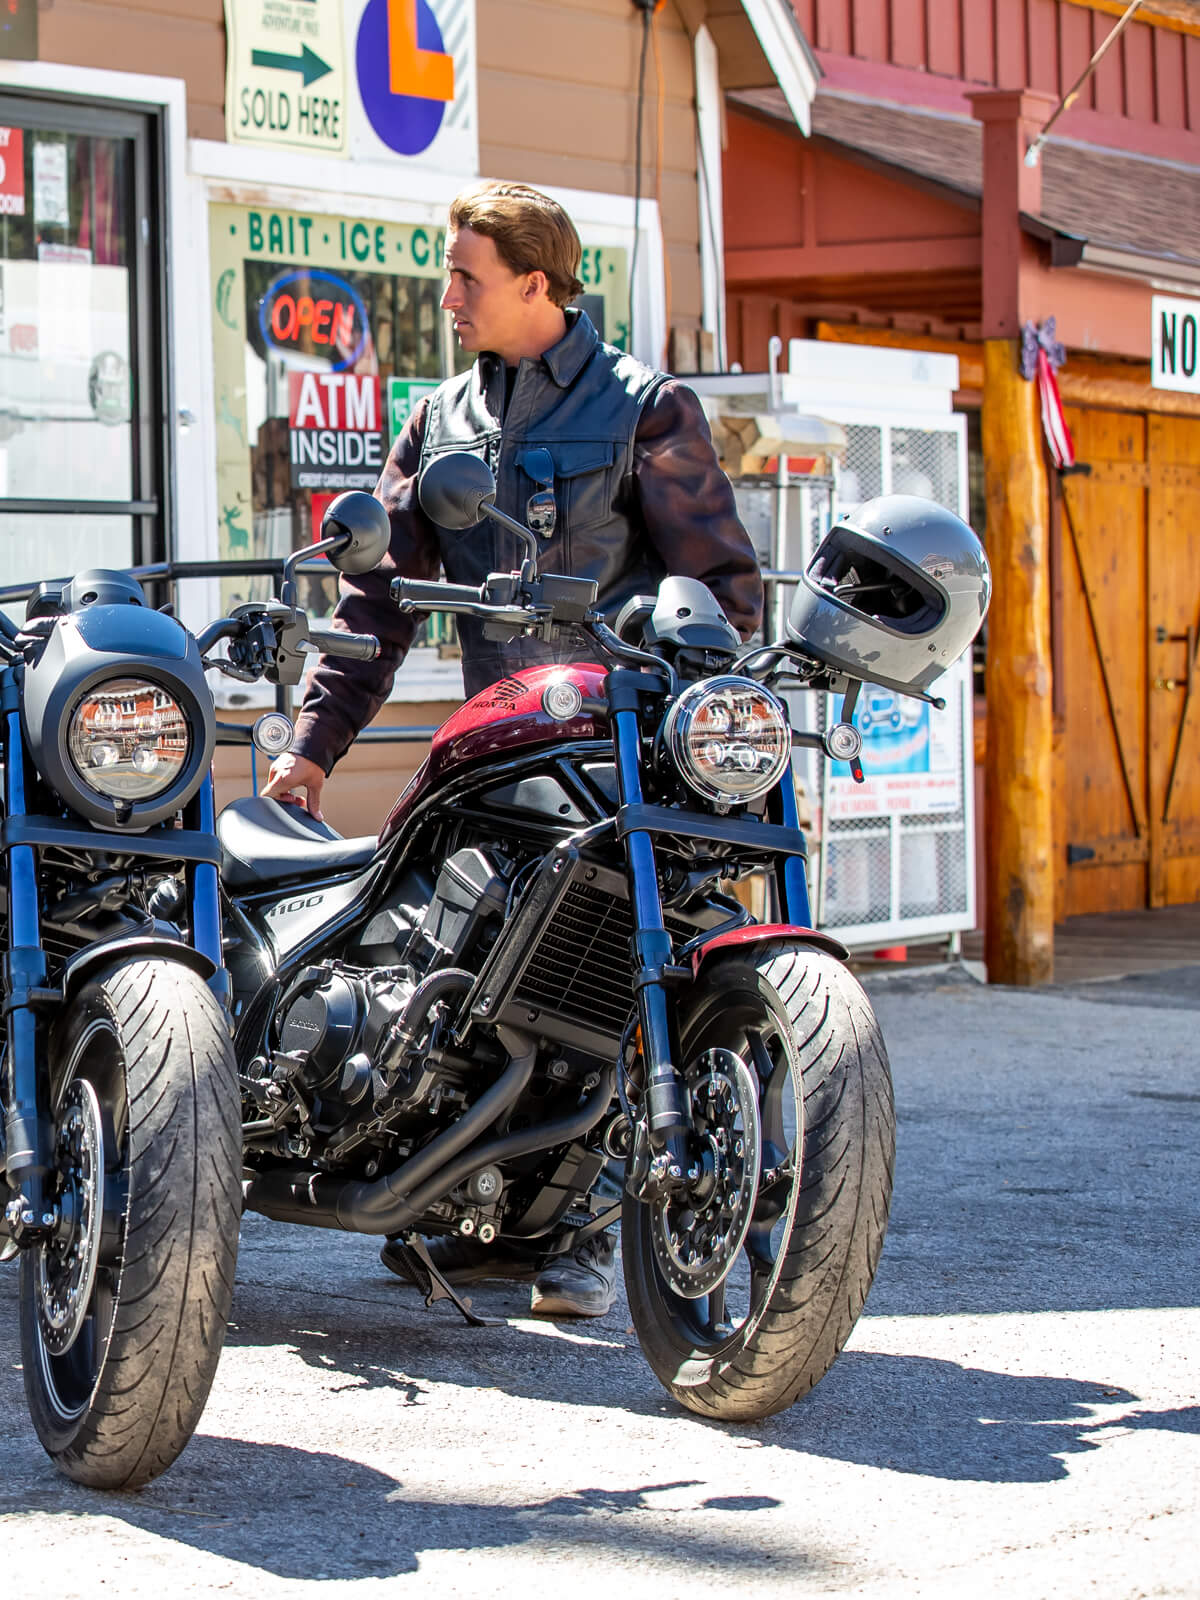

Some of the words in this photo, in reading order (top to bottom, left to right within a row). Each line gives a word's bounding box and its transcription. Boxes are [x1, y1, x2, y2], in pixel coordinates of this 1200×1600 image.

[240, 87, 290, 131] SOLD
[298, 94, 340, 139] HERE
[248, 211, 313, 256] BAIT
[340, 221, 387, 263] ICE
[271, 295, 355, 347] OPEN
[1161, 310, 1197, 377] NO
[295, 373, 376, 430] ATM
[290, 430, 383, 466] INSIDE
[471, 700, 517, 711] HONDA
[270, 895, 324, 917] 1100
